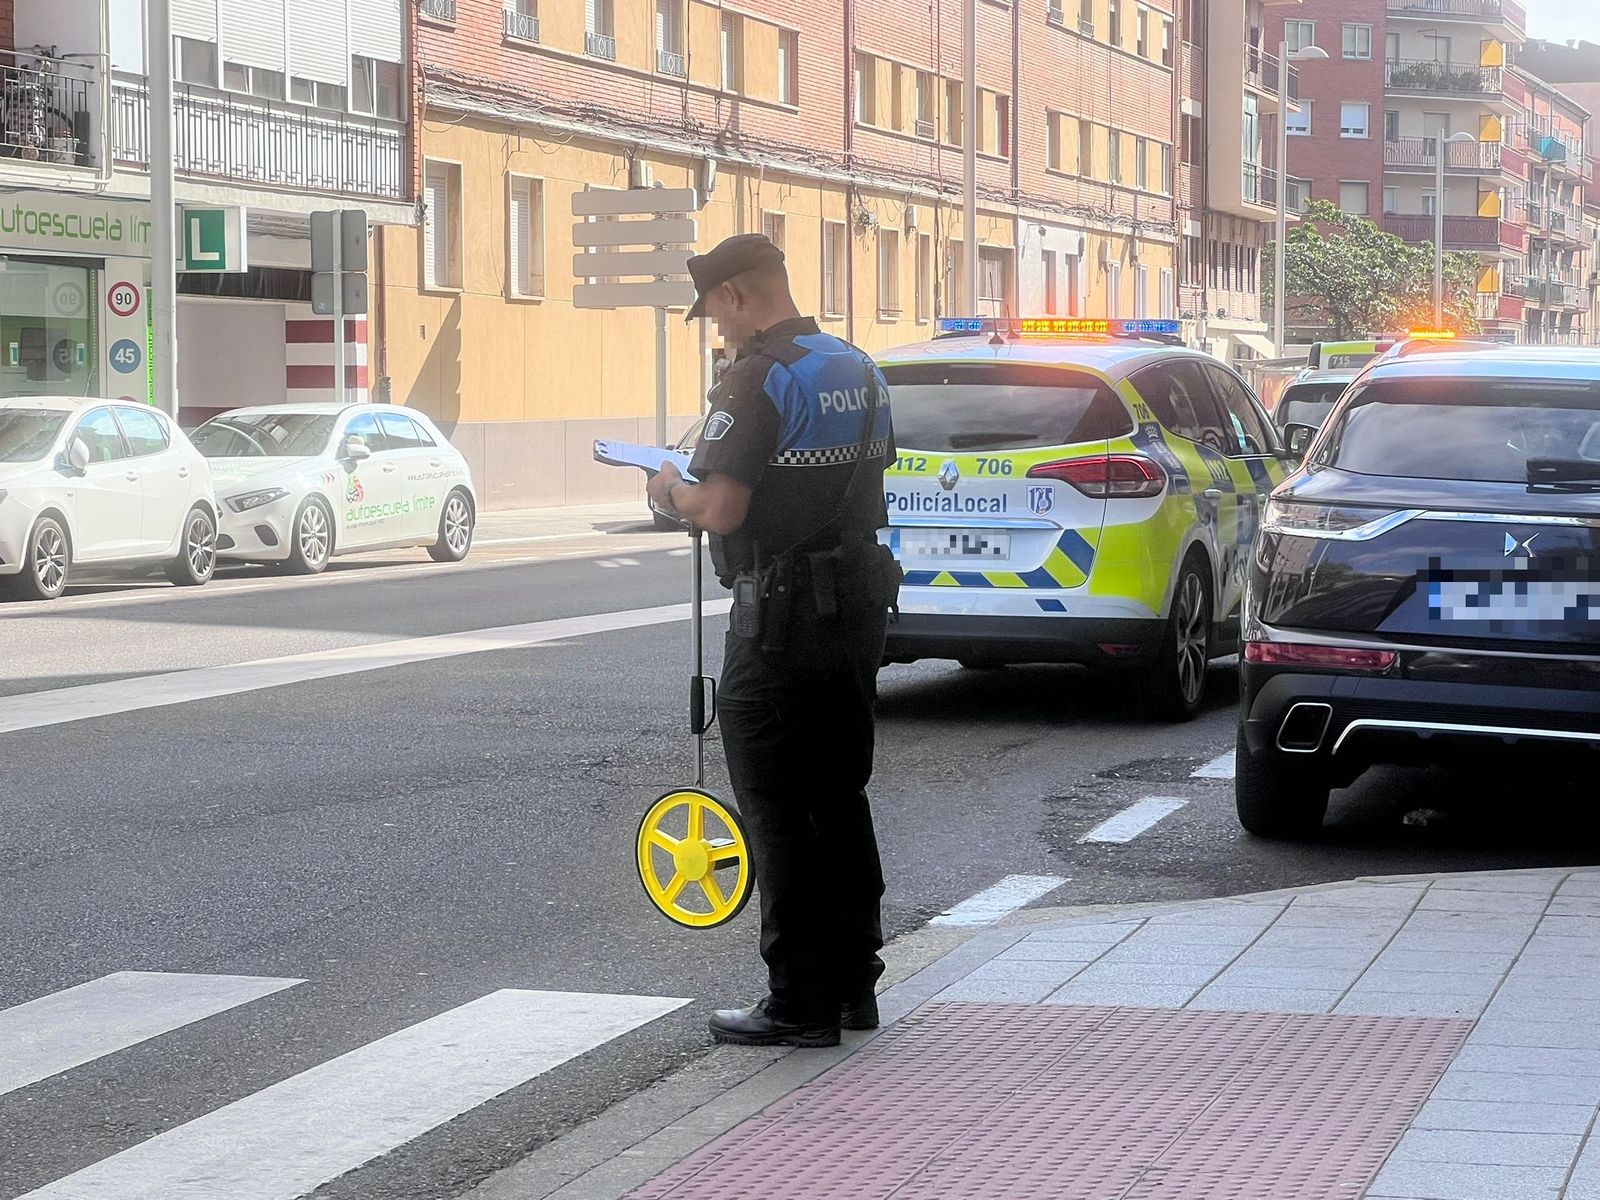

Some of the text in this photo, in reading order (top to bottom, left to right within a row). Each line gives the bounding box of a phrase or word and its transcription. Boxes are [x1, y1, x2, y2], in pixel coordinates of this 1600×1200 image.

[0, 203, 151, 243] utoescuela lím
[191, 217, 219, 260] L
[115, 293, 132, 305] 90
[115, 348, 135, 363] 45
[819, 385, 890, 415] POLICA
[896, 457, 928, 472] 112
[976, 457, 1012, 475] 706
[346, 497, 410, 521] autoescuela
